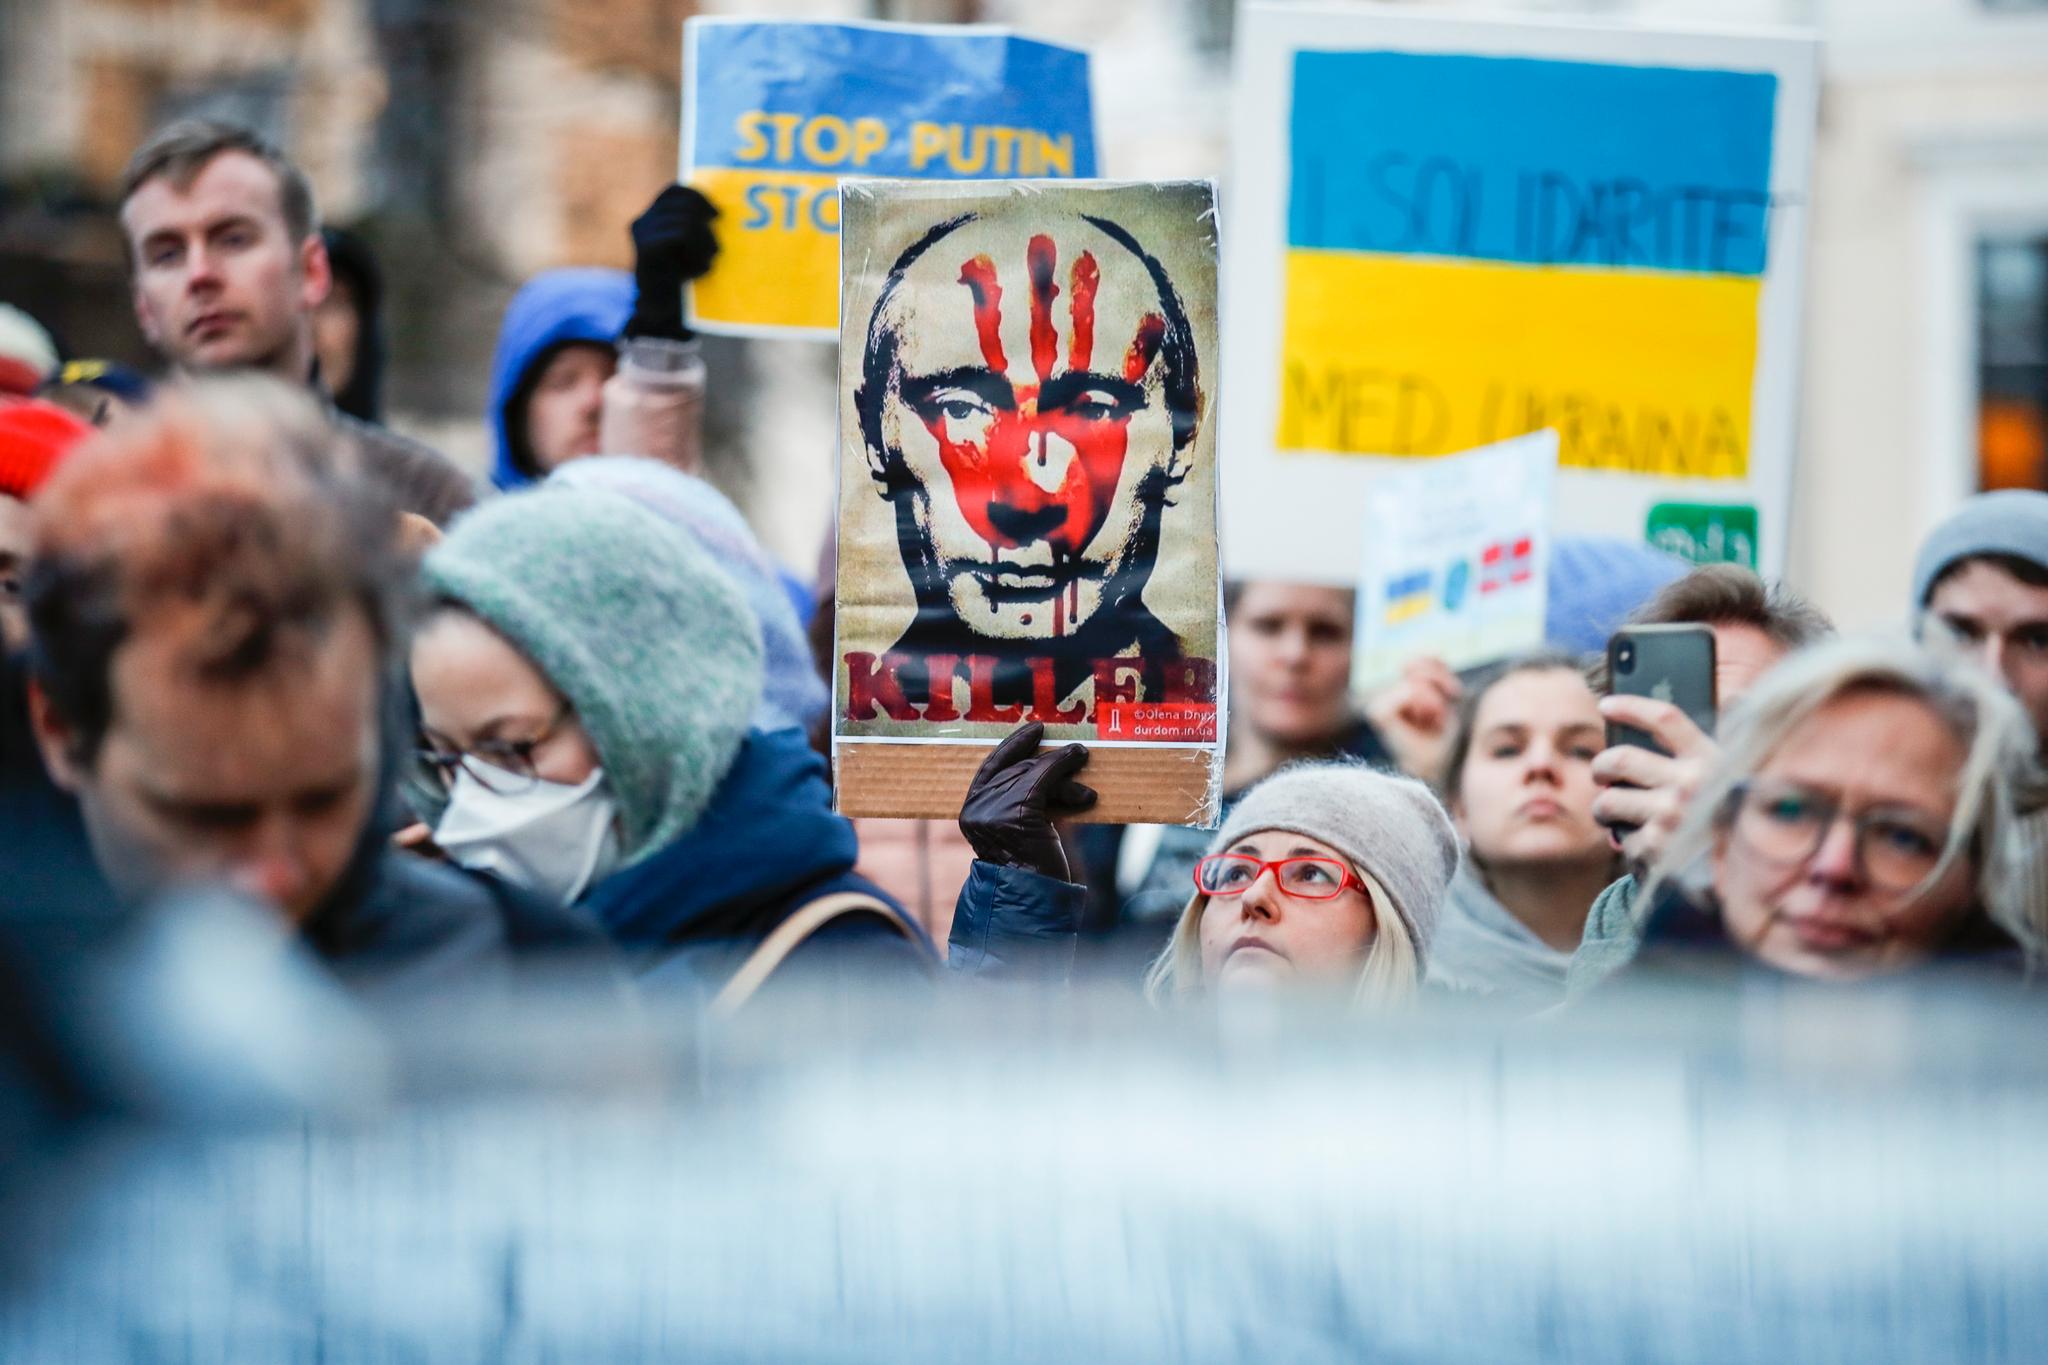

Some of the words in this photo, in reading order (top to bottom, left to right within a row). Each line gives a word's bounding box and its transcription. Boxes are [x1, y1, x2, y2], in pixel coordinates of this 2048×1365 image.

[737, 110, 889, 167] STOP
[909, 120, 1074, 177] PUTIN
[1284, 362, 1454, 456] MED
[843, 650, 1216, 724] KILLER
